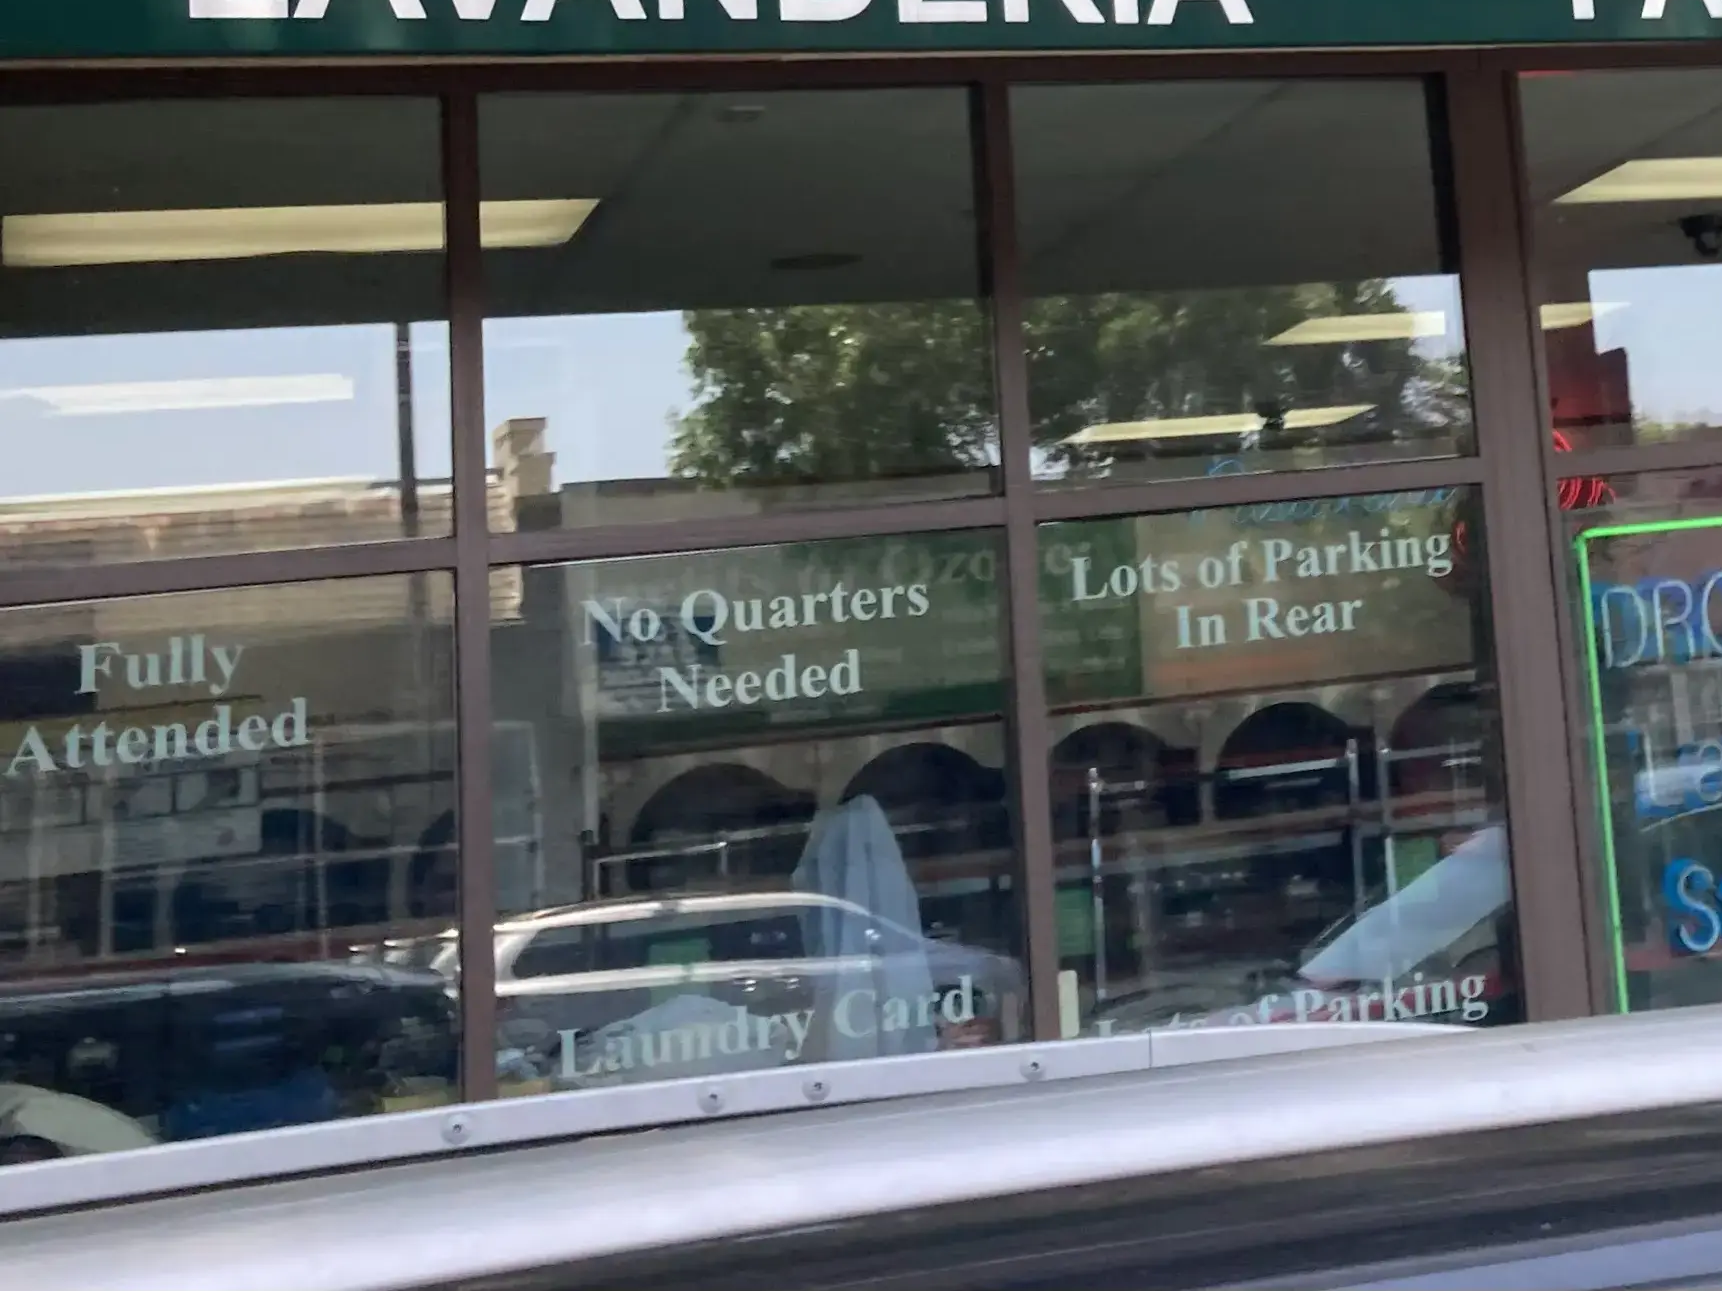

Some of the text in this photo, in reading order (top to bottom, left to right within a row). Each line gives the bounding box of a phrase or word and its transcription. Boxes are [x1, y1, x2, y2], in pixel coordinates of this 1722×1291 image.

[1069, 553, 1181, 603] Lots
[1199, 540, 1249, 590] of
[1261, 526, 1455, 585] Parking
[581, 580, 930, 647] No Quarters
[1176, 596, 1364, 649] In Rear
[74, 633, 245, 695] Fully
[656, 649, 864, 714] Needed
[5, 697, 312, 778] Attended
[557, 974, 976, 1079] Laundry Card
[1293, 970, 1490, 1023] Parking
